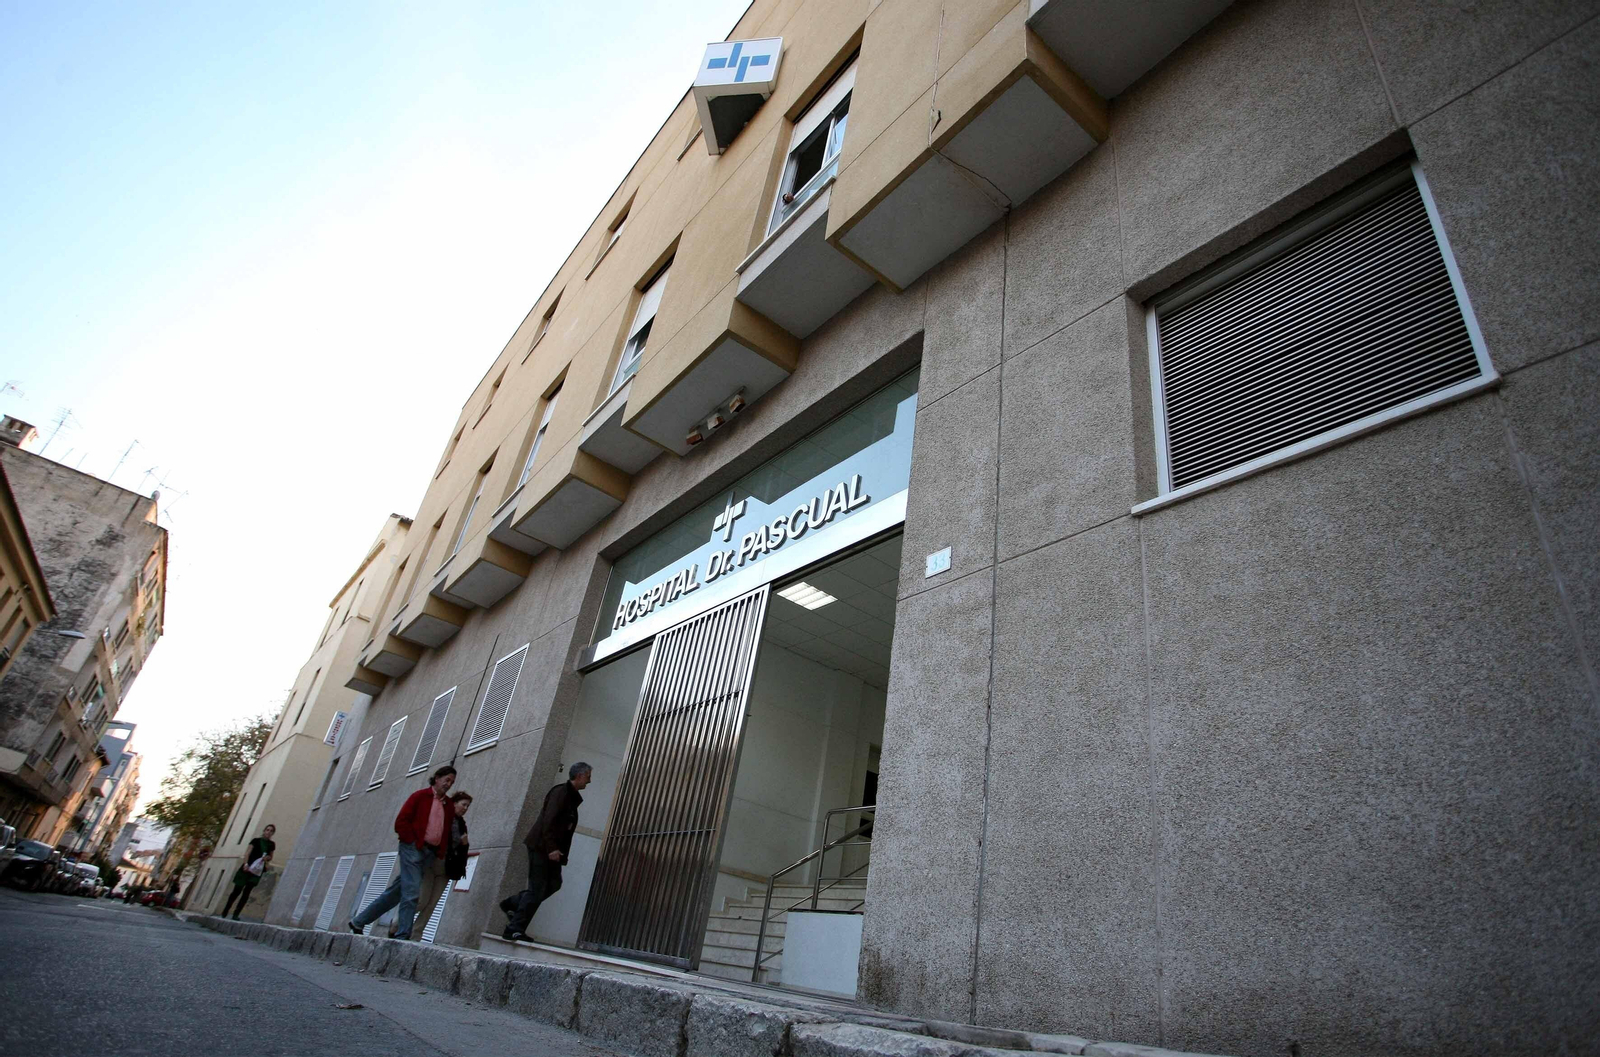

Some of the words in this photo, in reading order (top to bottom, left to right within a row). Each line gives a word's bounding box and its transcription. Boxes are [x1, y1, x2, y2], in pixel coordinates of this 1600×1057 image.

[613, 564, 701, 630] HOSPITAL
[705, 550, 735, 583] Dr.
[737, 474, 871, 566] PASCUAL
